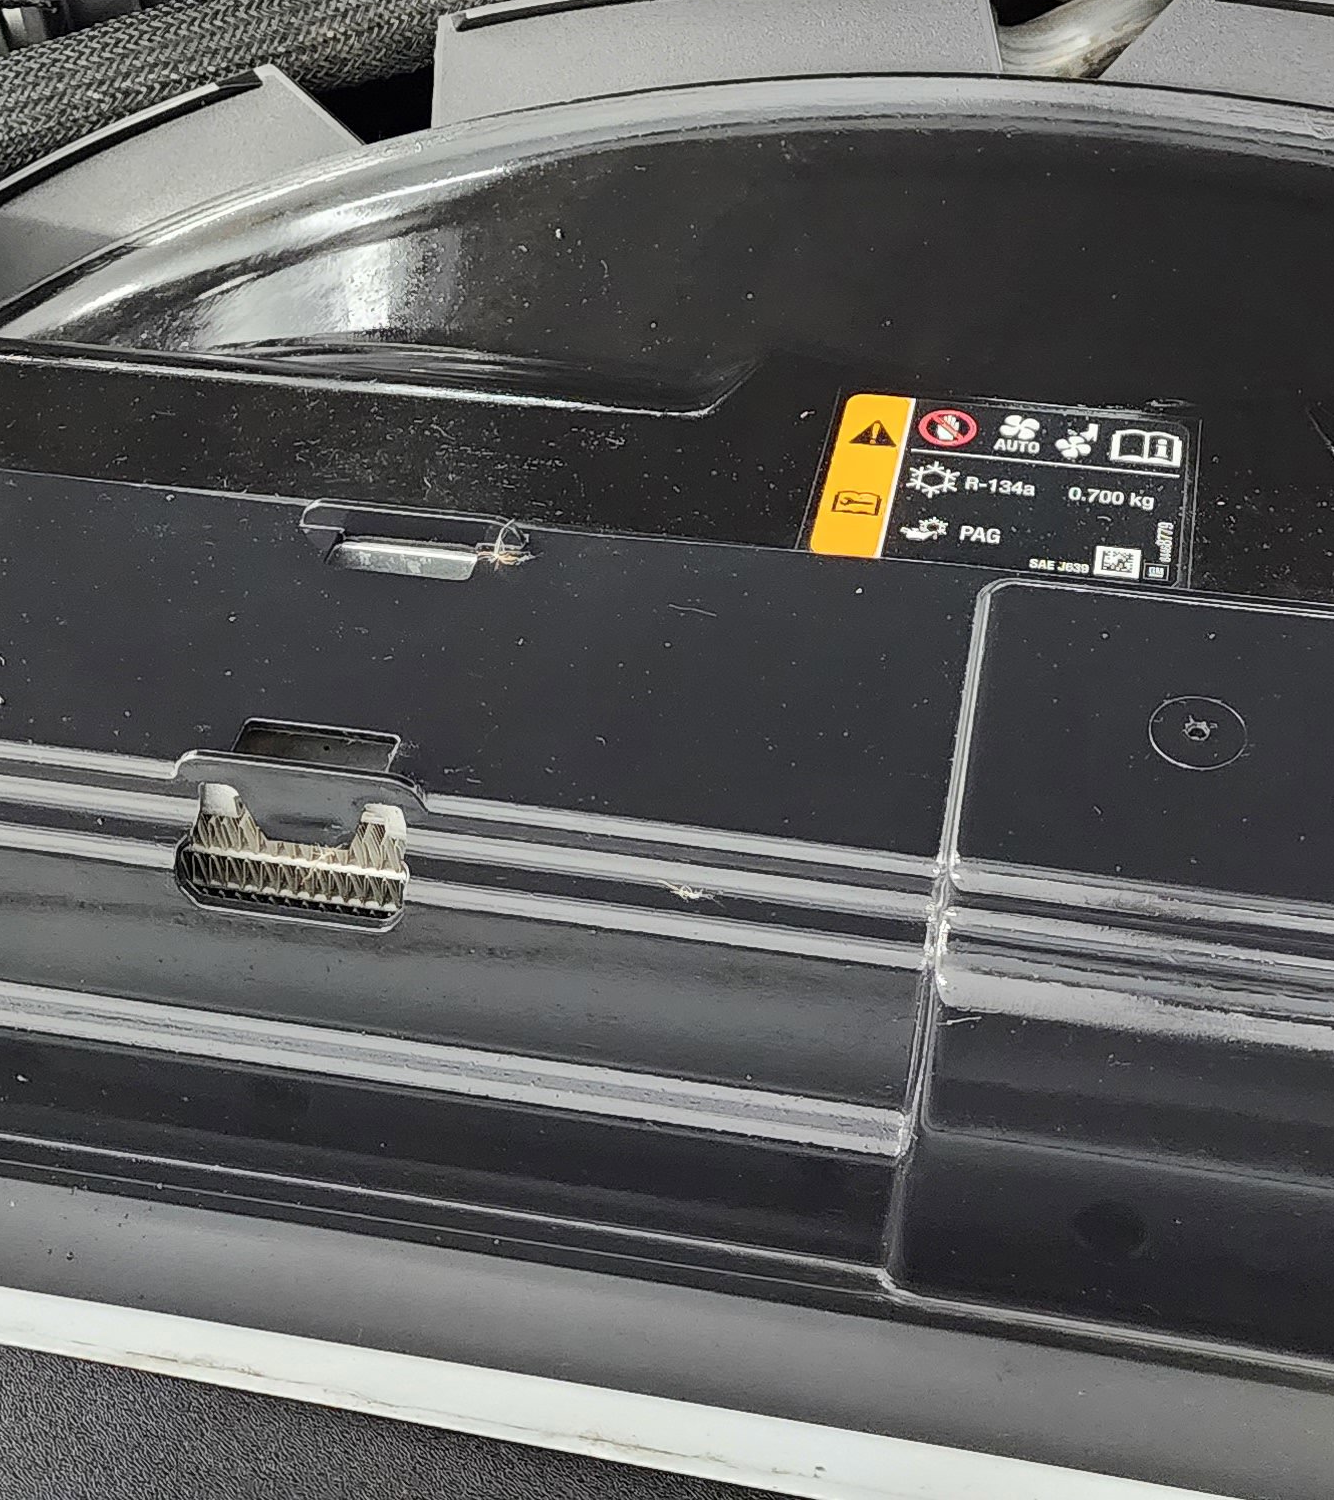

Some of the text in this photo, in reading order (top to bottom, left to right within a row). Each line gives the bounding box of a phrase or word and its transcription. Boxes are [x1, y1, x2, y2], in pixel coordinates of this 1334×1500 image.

[993, 438, 1040, 454] AUTO
[964, 476, 1155, 511] R-134a 0.700 kg
[959, 525, 1001, 544] PAG
[1028, 558, 1090, 575] SAE J639
